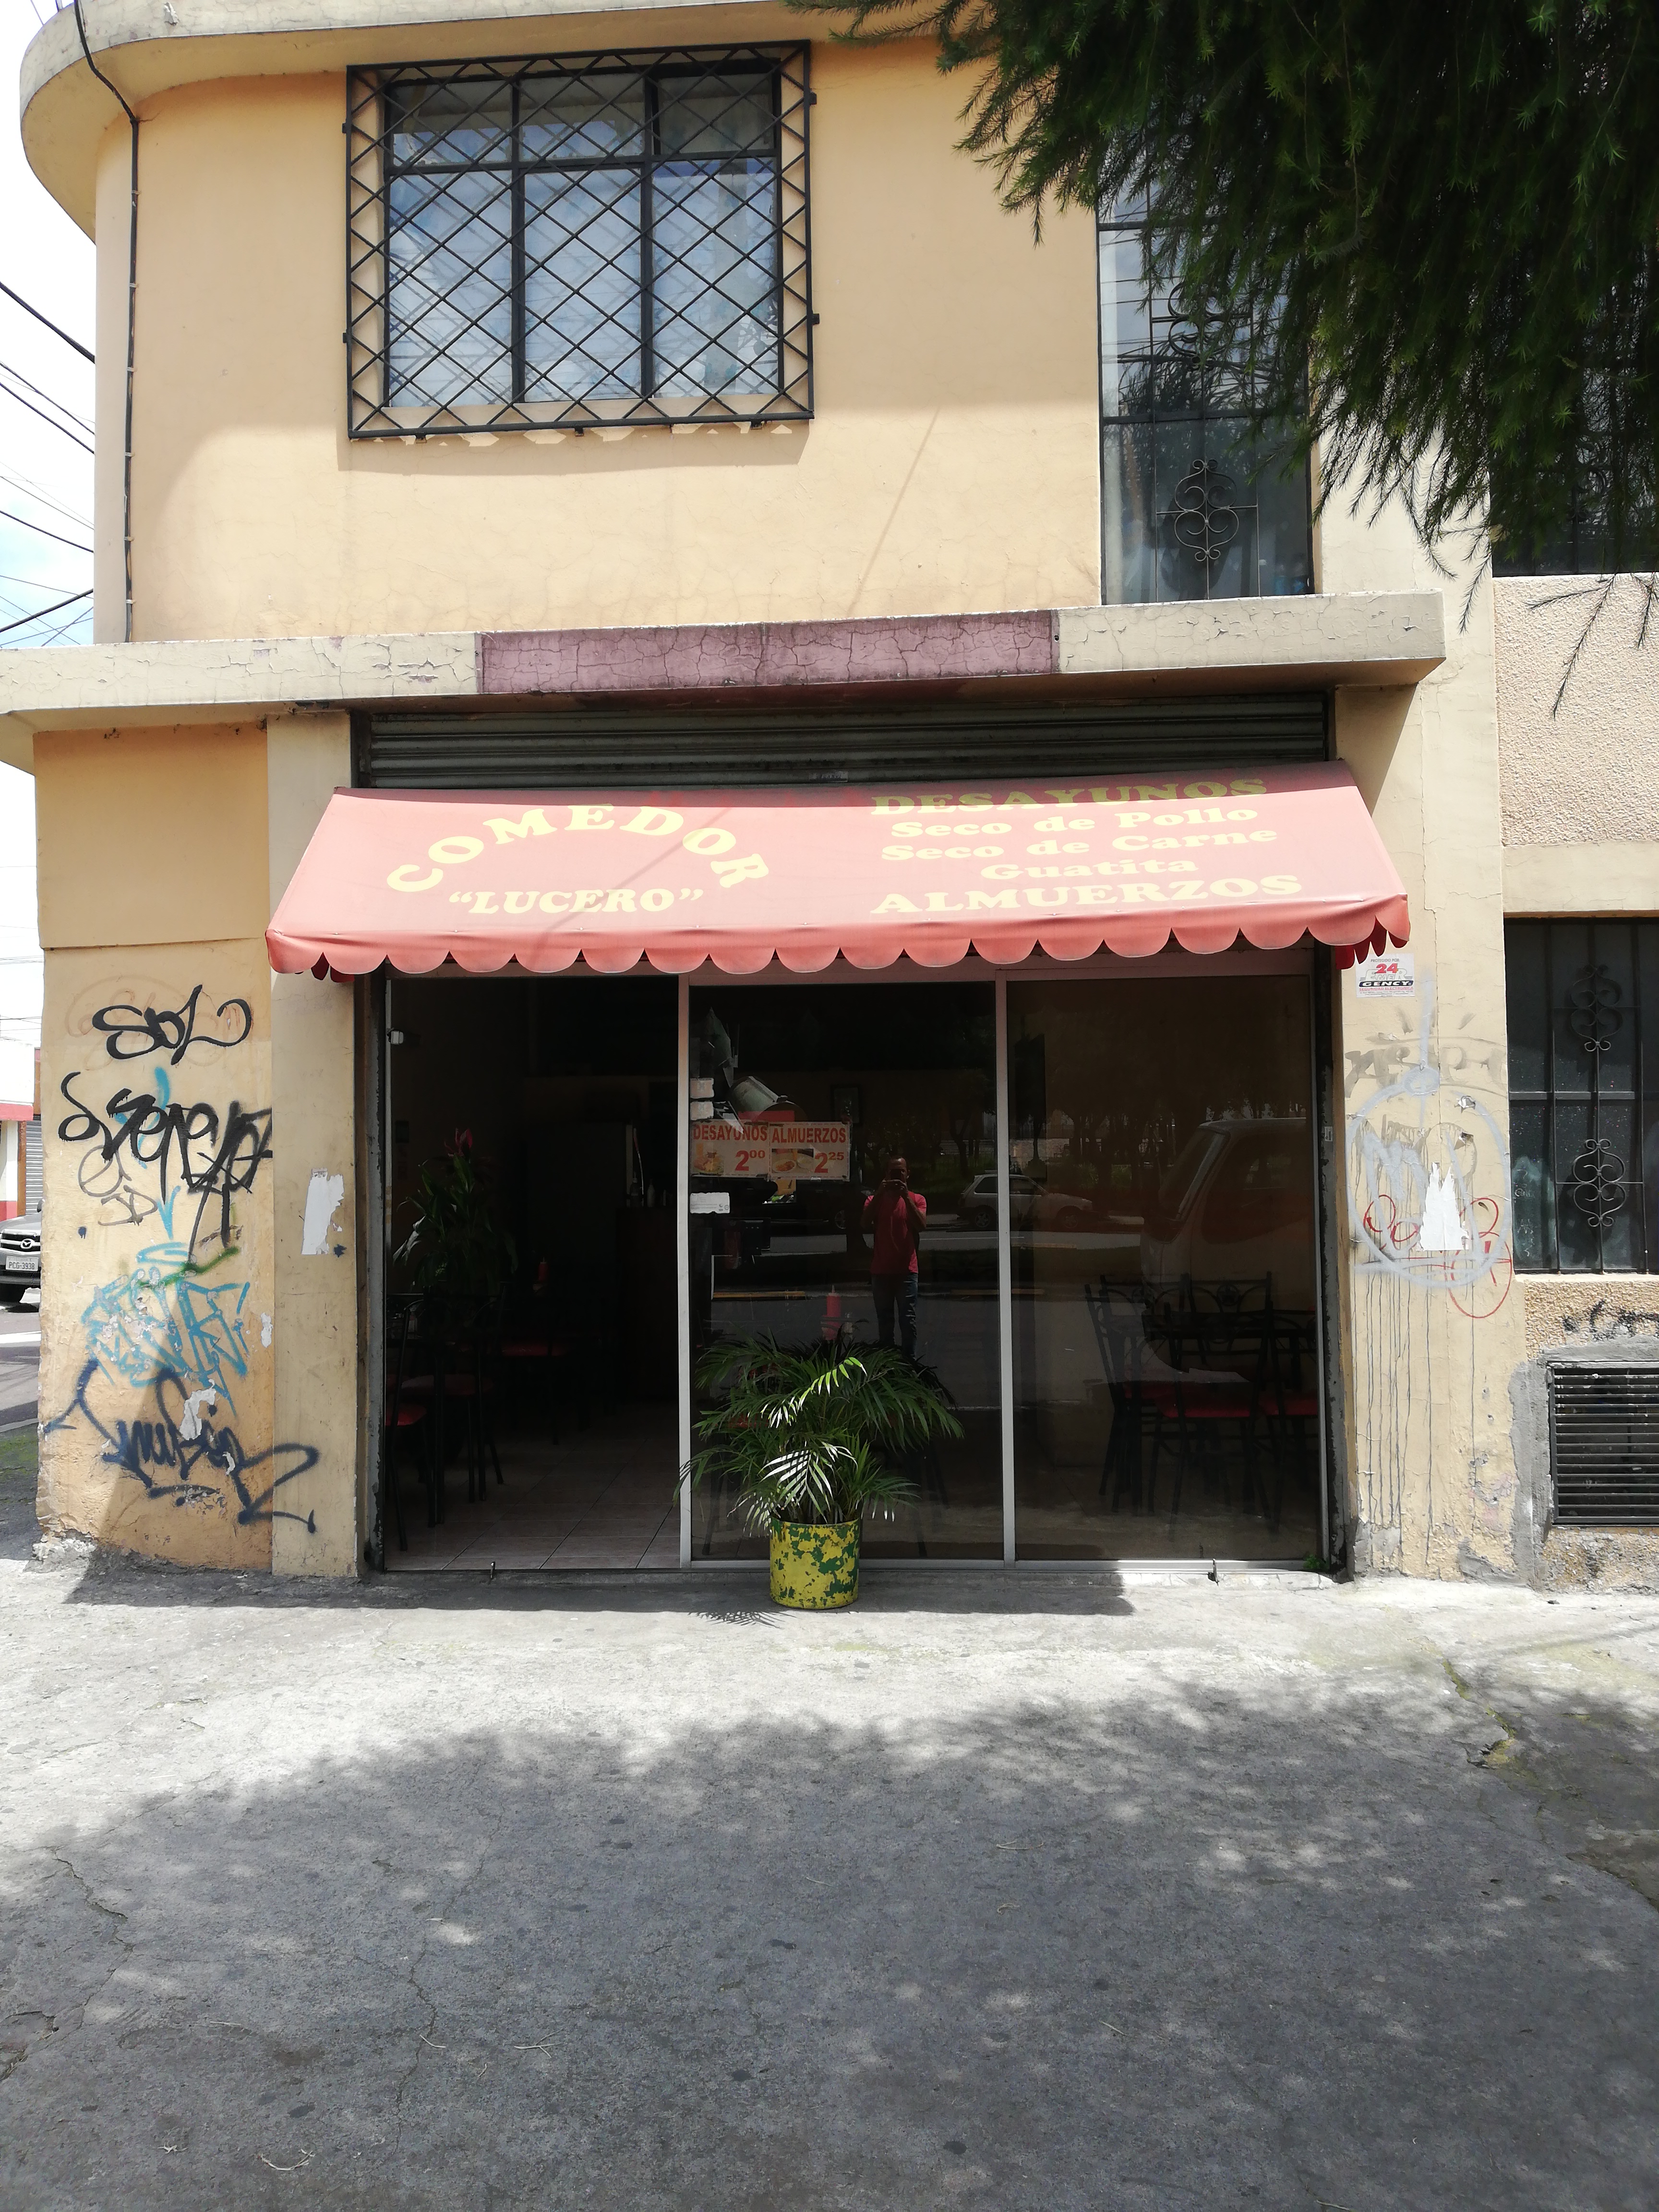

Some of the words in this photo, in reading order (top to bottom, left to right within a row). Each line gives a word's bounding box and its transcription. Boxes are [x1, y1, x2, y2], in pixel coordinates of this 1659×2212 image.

[870, 778, 1267, 816] DESAYUNOS
[891, 821, 1012, 837] Seco
[1034, 816, 1095, 832] de
[1115, 807, 1258, 828] Pollo
[386, 803, 769, 893] COMEDOR
[881, 844, 1005, 861] Seco
[1026, 840, 1090, 855] de
[1112, 829, 1278, 852] Carne
[980, 858, 1199, 880] Guatita
[870, 875, 1302, 914] ALMUERZOS
[1376, 963, 1398, 974] 24
[693, 1124, 768, 1141] DESAYUNOS
[771, 1128, 846, 1143] ALMUERZOS
[8, 1262, 35, 1270] PCG-3938
